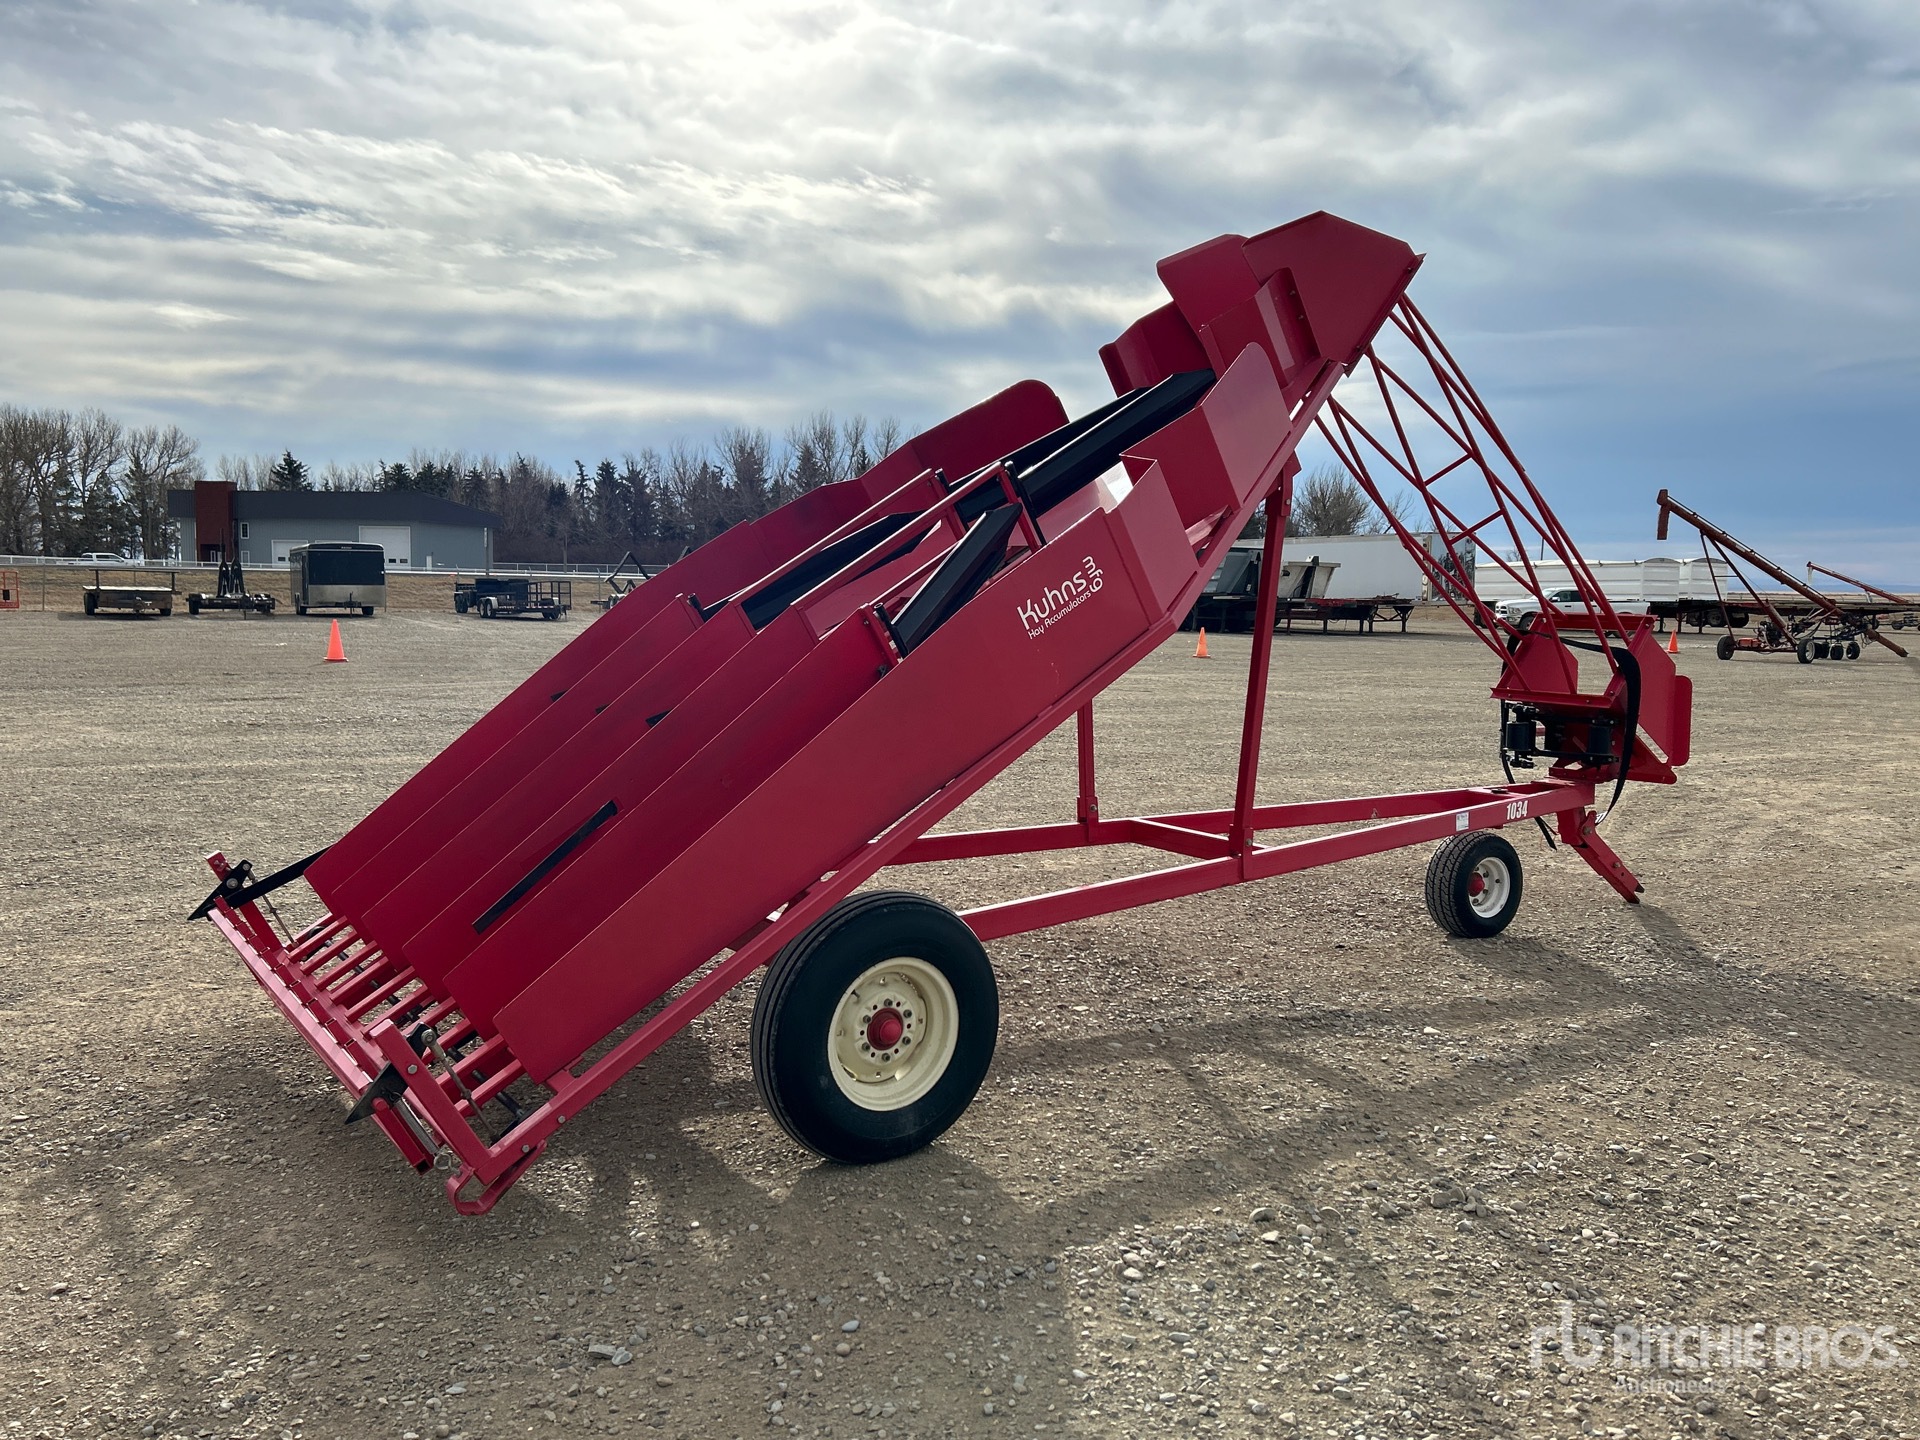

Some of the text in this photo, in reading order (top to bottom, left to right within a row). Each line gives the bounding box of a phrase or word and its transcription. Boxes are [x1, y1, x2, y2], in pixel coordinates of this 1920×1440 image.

[1017, 571, 1086, 630] Kuhns
[1028, 591, 1091, 639] Hay Accumulators
[1507, 800, 1528, 820] 1034
